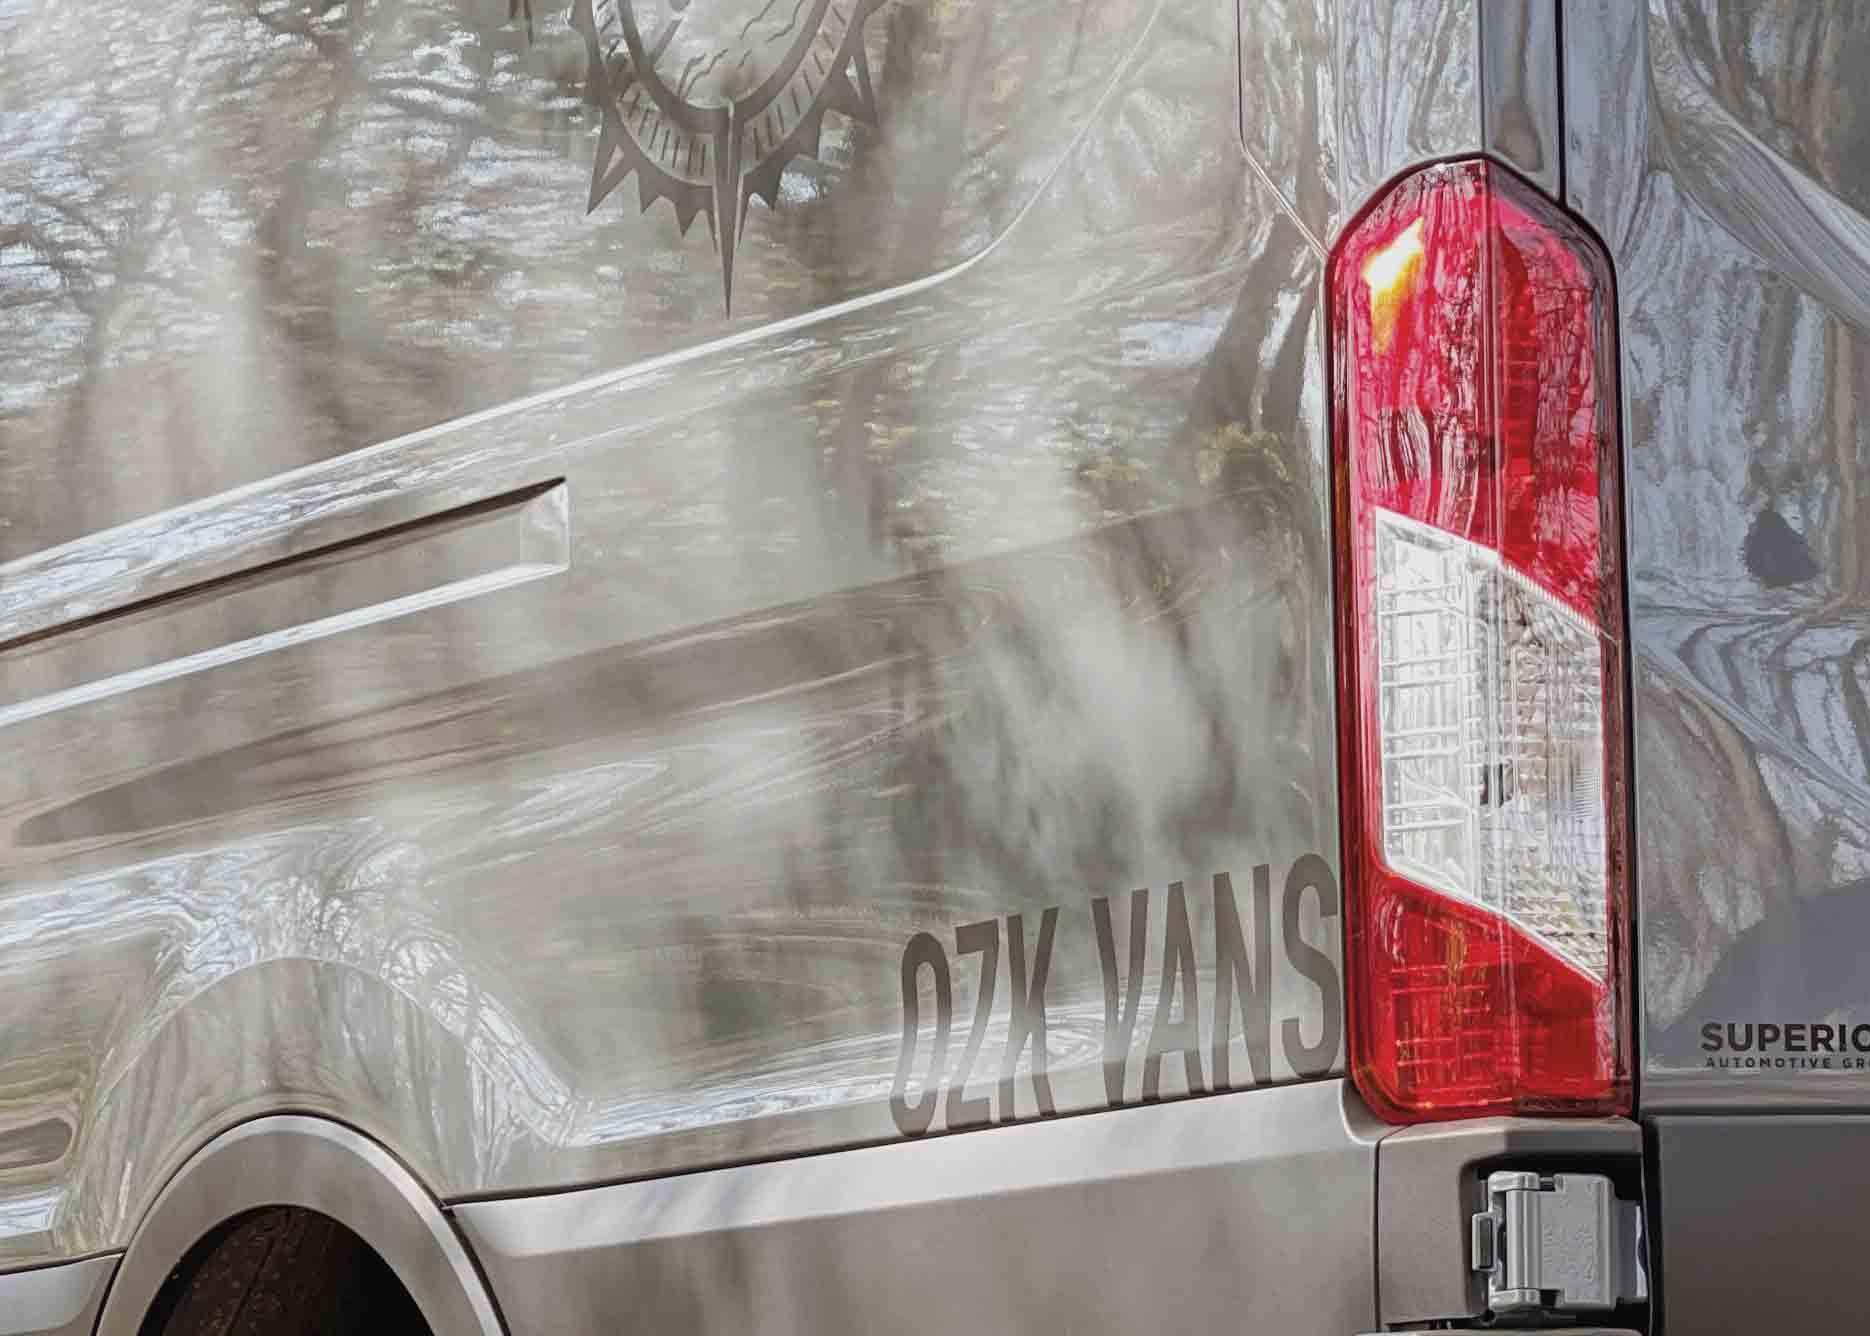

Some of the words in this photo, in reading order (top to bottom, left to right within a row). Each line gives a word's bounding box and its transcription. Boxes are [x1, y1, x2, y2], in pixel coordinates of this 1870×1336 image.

[889, 906, 1060, 1138] OZK
[1091, 853, 1342, 1108] VANS
[1705, 1057, 1832, 1069] AUTOMOTIVE
